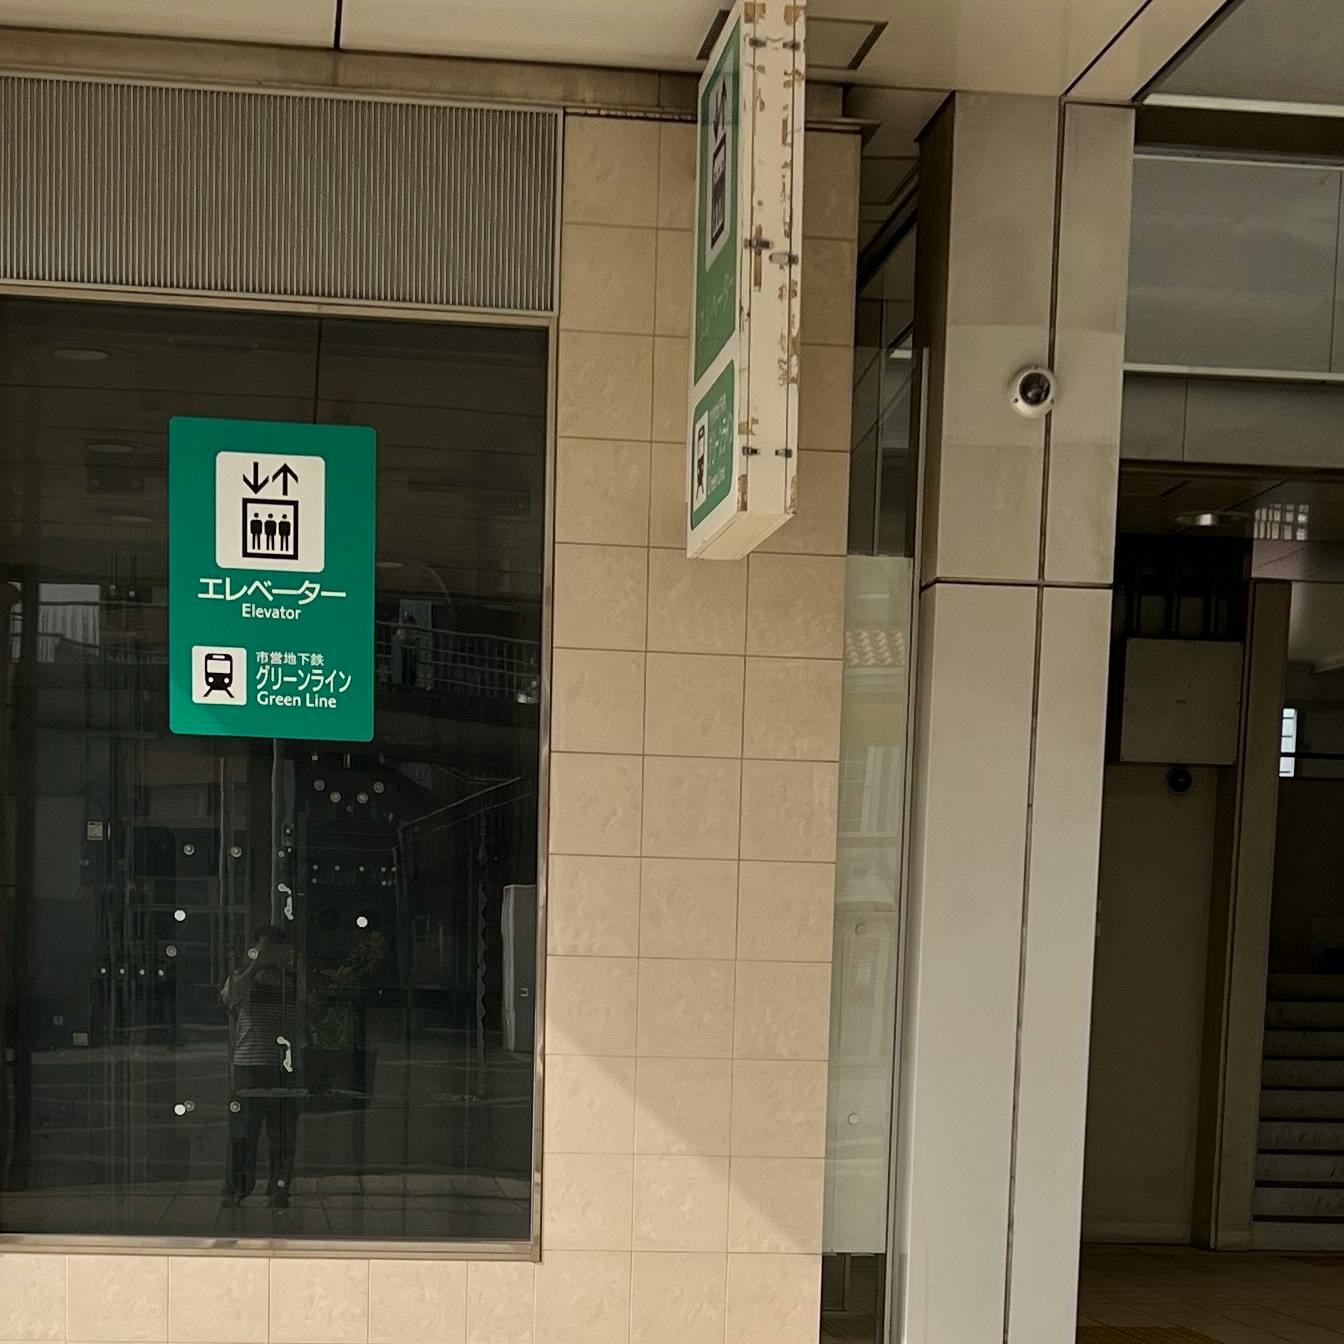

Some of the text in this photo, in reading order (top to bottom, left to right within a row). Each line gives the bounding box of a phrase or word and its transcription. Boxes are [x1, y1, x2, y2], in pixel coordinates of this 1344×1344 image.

[198, 577, 347, 605] エレベーター
[242, 603, 302, 620] Elevator
[256, 651, 325, 667] 市営地下鉄
[256, 665, 352, 693] グリーンライン
[256, 690, 337, 709] Green Line
